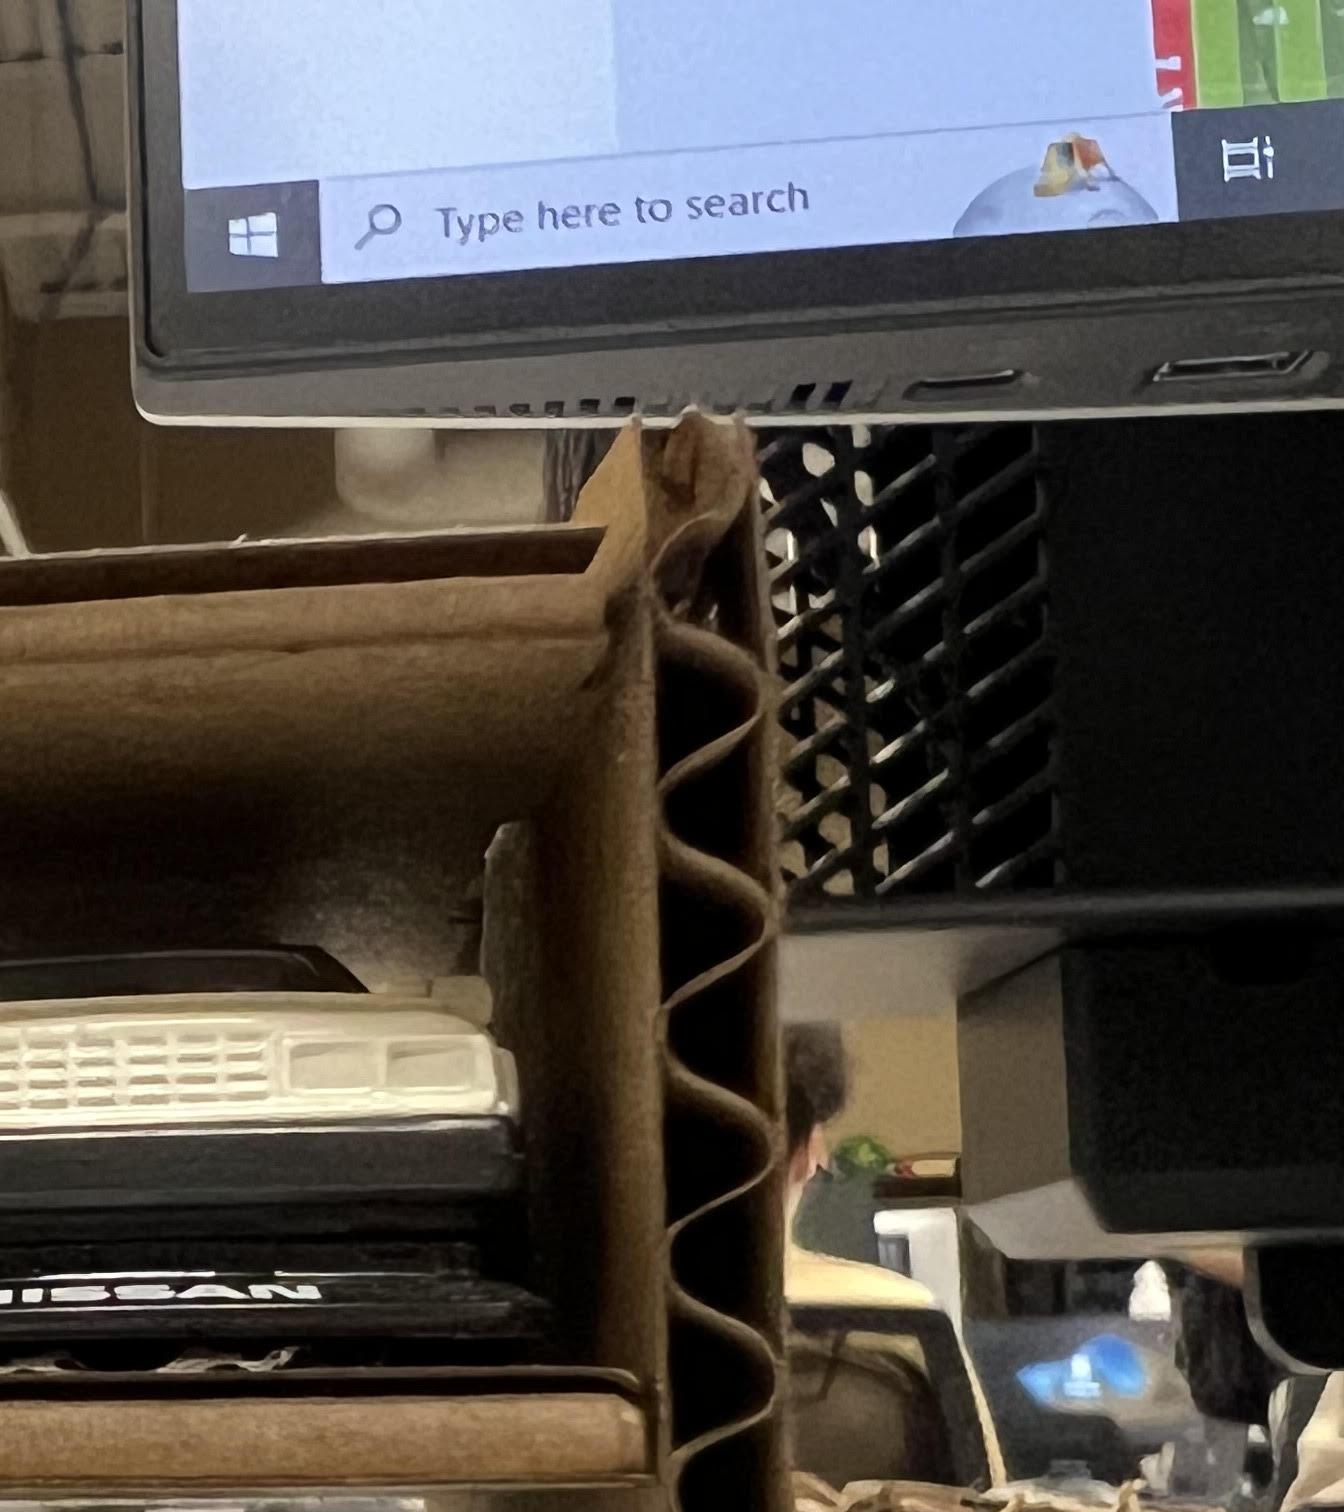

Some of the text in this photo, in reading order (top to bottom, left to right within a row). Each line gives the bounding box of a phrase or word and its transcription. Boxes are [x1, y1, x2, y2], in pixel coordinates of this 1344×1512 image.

[435, 181, 810, 246] Type here to search
